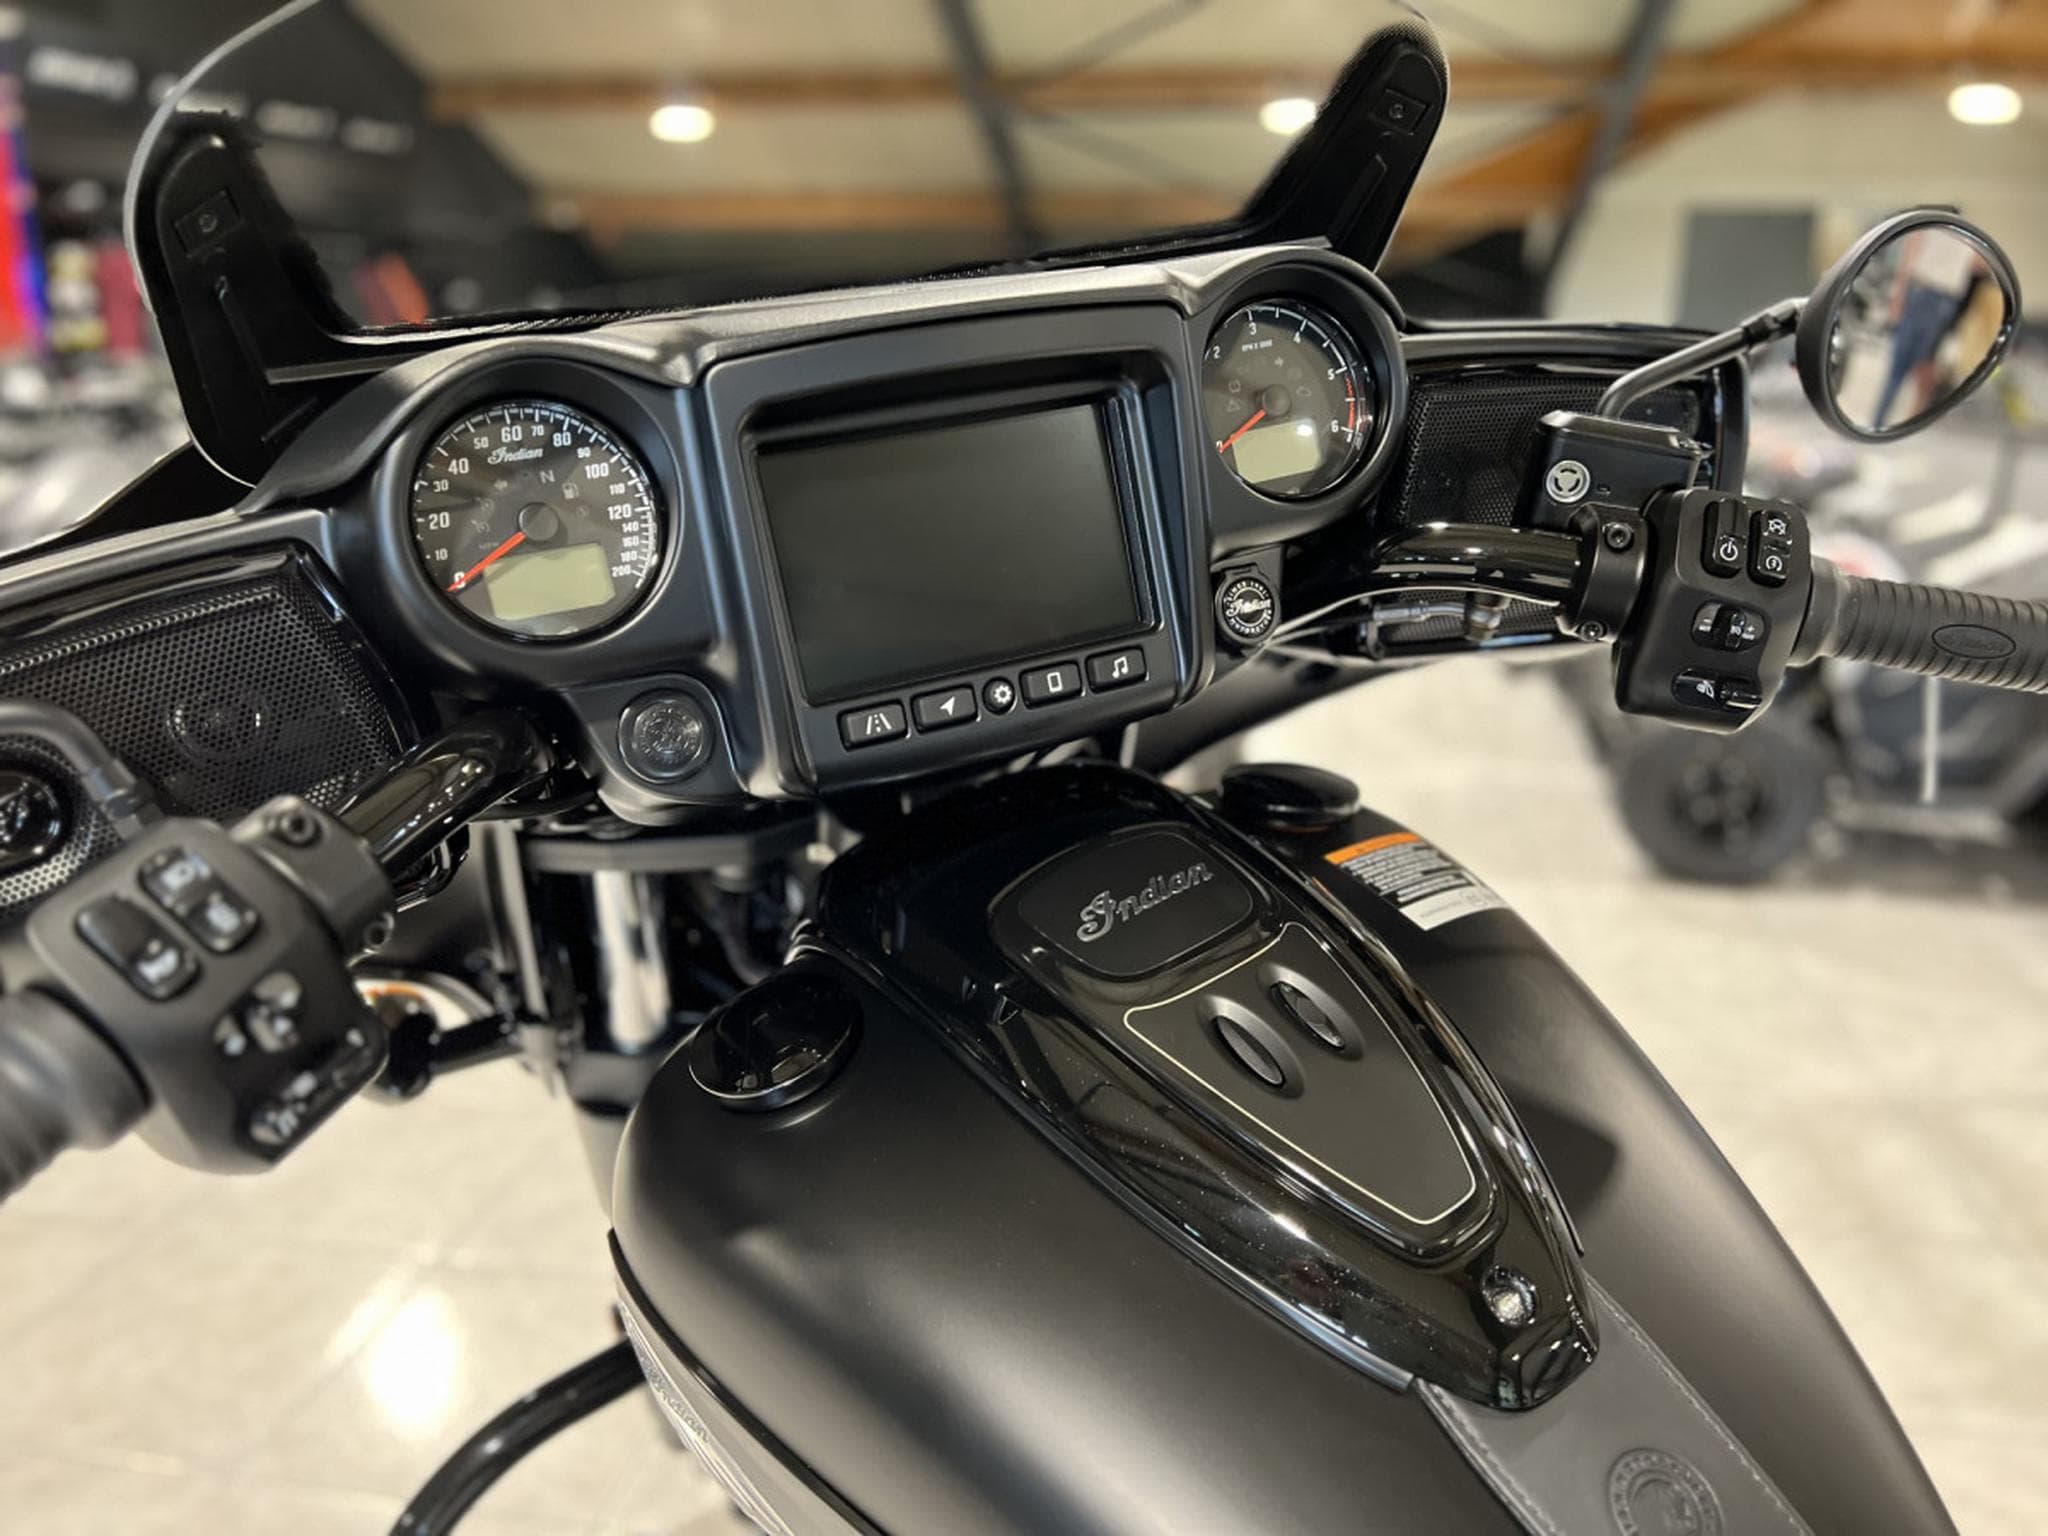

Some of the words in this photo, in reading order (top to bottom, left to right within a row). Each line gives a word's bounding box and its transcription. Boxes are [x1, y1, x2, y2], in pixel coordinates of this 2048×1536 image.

[1249, 322, 1257, 335] 3
[1293, 331, 1301, 344] 4
[1213, 346, 1221, 359] 2
[1327, 368, 1335, 380] 5
[501, 425, 522, 442] 60
[531, 424, 545, 436] 70
[1331, 420, 1339, 433] 6
[473, 437, 489, 450] 50
[553, 431, 571, 447] 80
[487, 447, 544, 465] Indian
[448, 457, 469, 475] 40
[585, 462, 609, 479] 100
[433, 479, 449, 493] 30
[607, 503, 632, 520] 120
[429, 511, 450, 530] 20
[622, 521, 639, 534] 140
[435, 548, 448, 561] 10
[611, 564, 631, 578] 200
[1076, 862, 1214, 942] Indian
